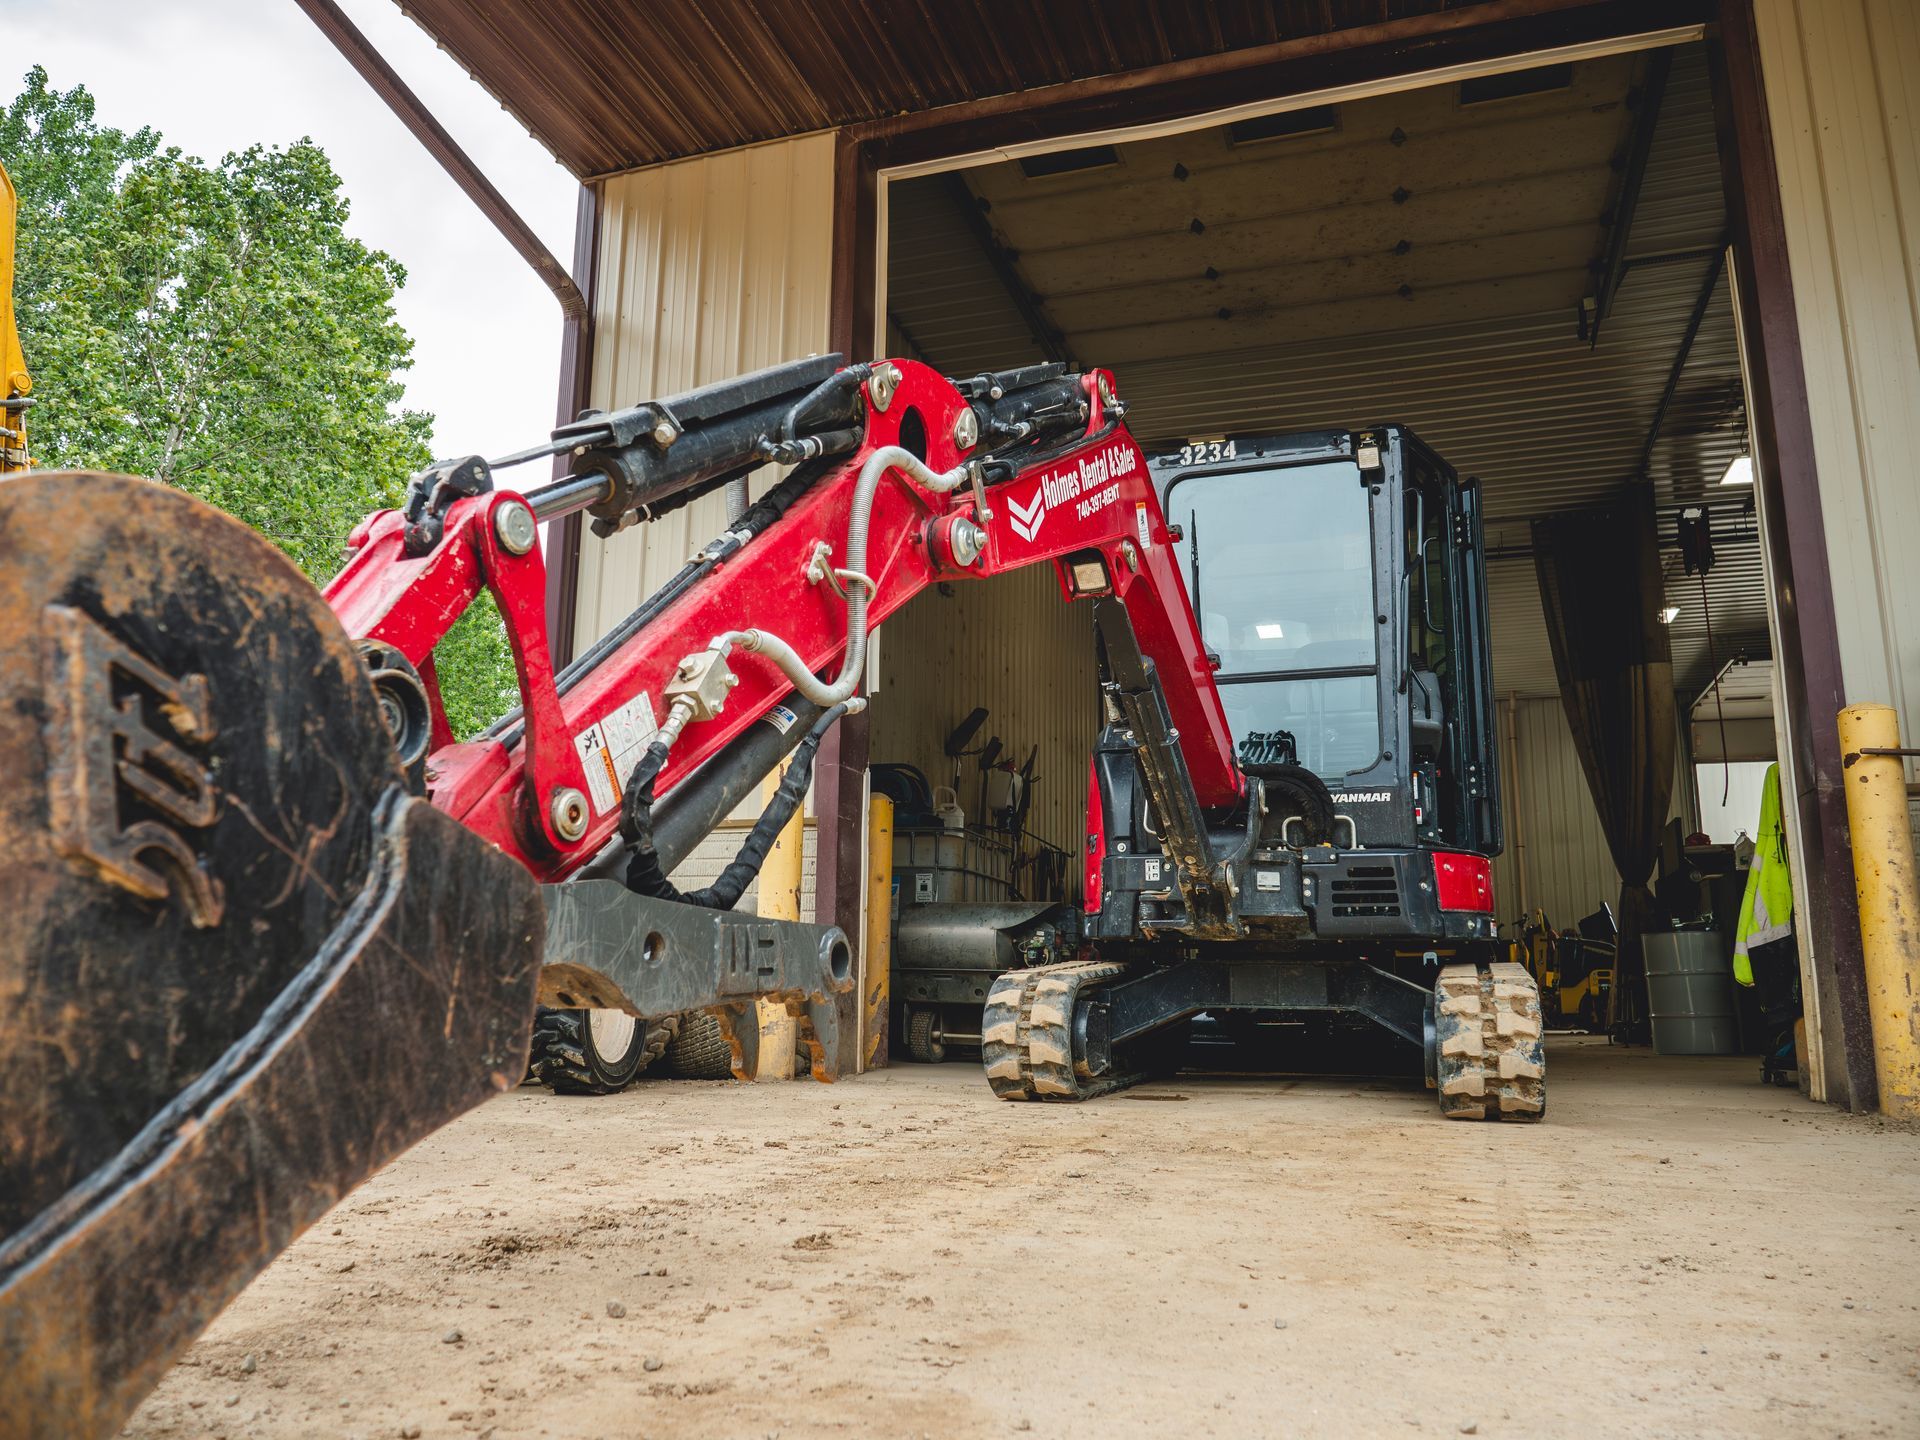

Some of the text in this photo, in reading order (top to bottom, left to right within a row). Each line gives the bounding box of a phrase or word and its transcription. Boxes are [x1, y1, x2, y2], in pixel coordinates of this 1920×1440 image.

[1180, 440, 1237, 466] 3234
[1041, 443, 1136, 511] Holmes Rental & Sales
[1076, 483, 1120, 521] 740-397-RENT
[1330, 792, 1392, 803] YANMAR
